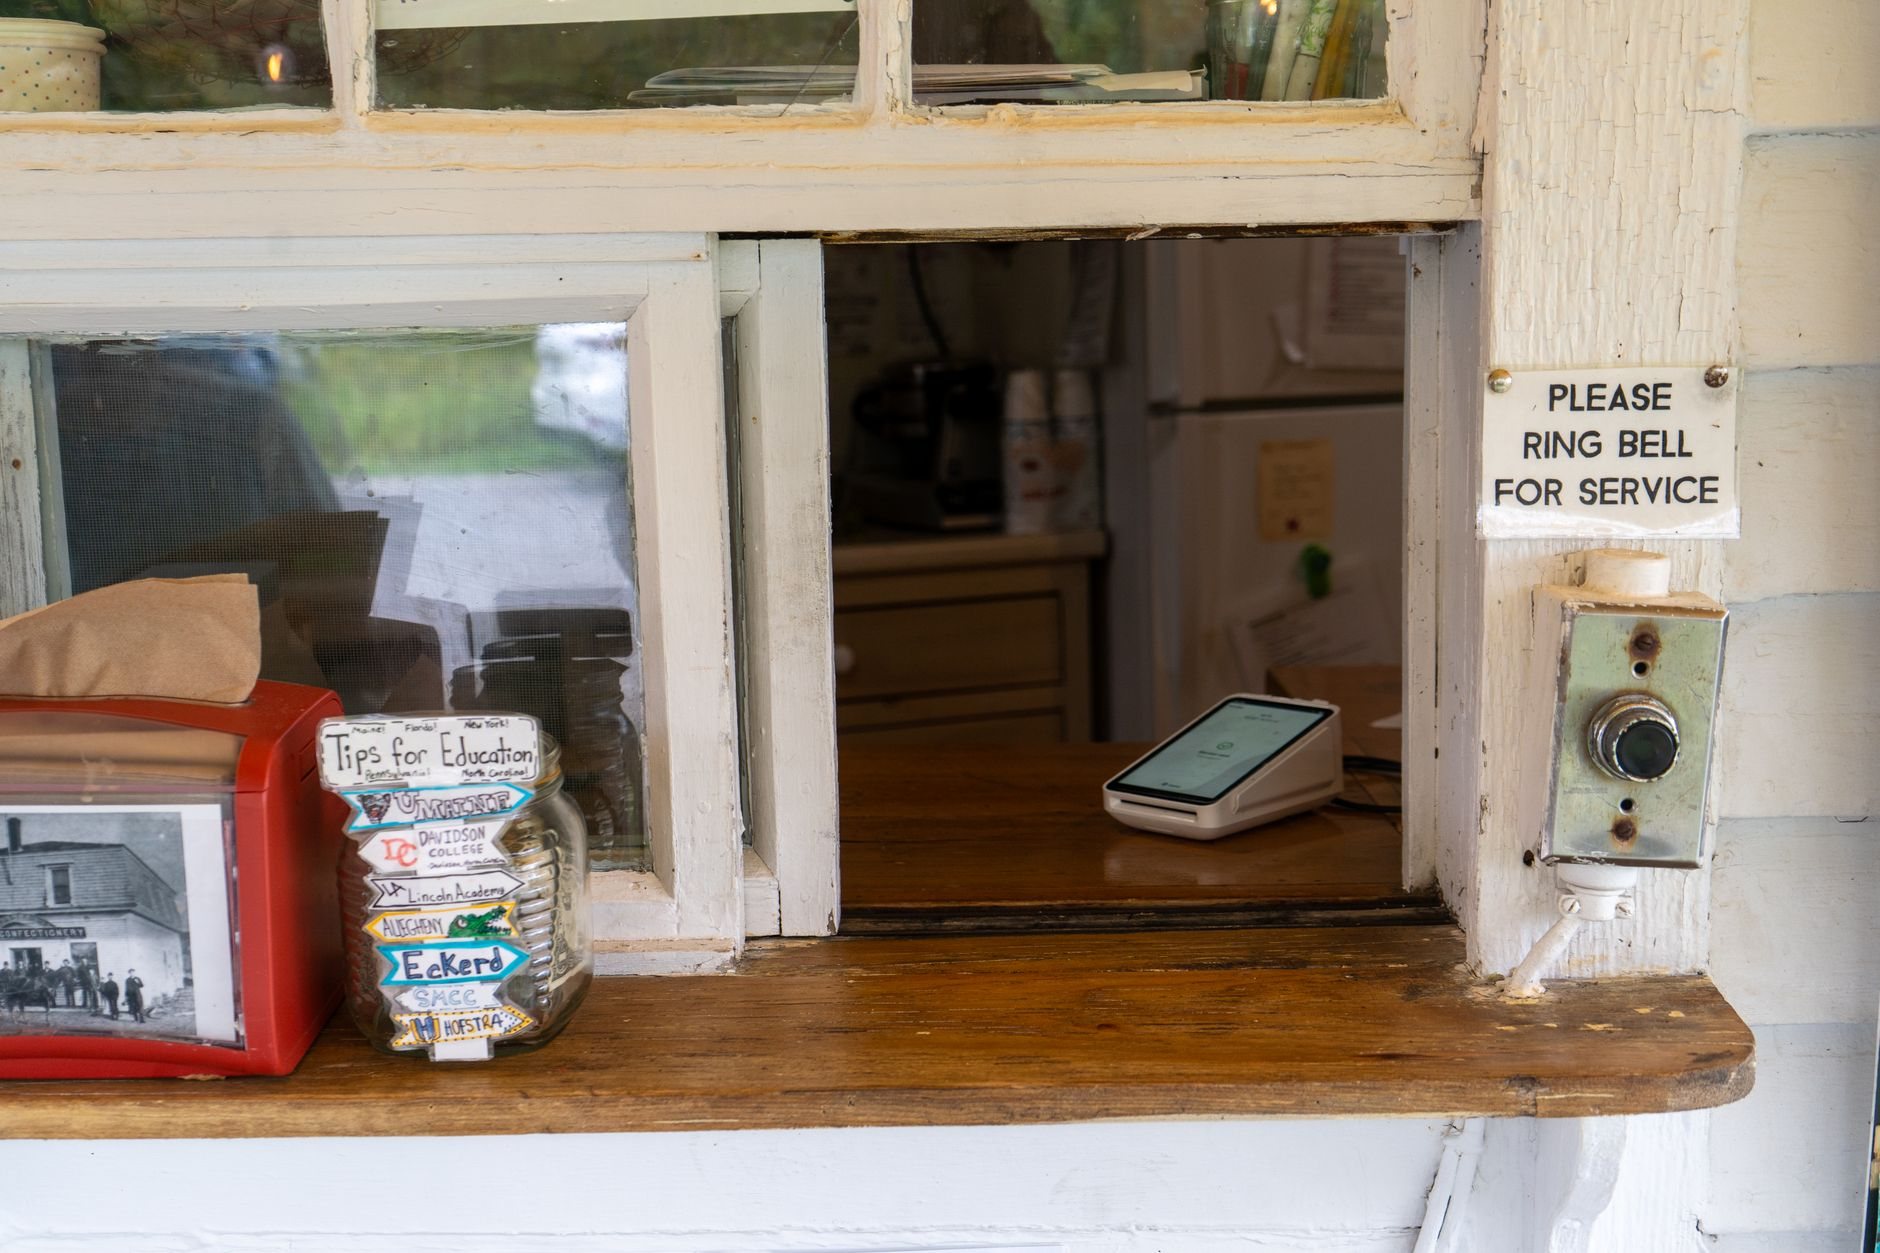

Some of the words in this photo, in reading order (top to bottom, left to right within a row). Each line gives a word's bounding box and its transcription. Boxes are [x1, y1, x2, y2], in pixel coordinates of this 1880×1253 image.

[1549, 383, 1672, 411] PLEASE
[1523, 431, 1602, 459] RING
[1618, 430, 1692, 457] BELL
[1495, 478, 1563, 506] FOR
[1579, 476, 1719, 505] SERVICE
[464, 719, 482, 729] New
[484, 719, 509, 728] York!
[325, 733, 381, 775] Tips
[392, 736, 427, 766] for
[440, 731, 533, 767] Education
[462, 768, 485, 777] North
[489, 766, 528, 777] Carolina!
[392, 791, 512, 820] UMAINE
[419, 825, 485, 847] DAVIDSON
[429, 843, 484, 858] COLLEGE
[408, 887, 453, 903] Lincoln
[455, 882, 505, 900] Academy
[383, 918, 444, 937] ALLEGHENY
[402, 946, 504, 979] Eckerd
[414, 989, 477, 1008] SMCC
[444, 1014, 503, 1037] HOFSTRA
